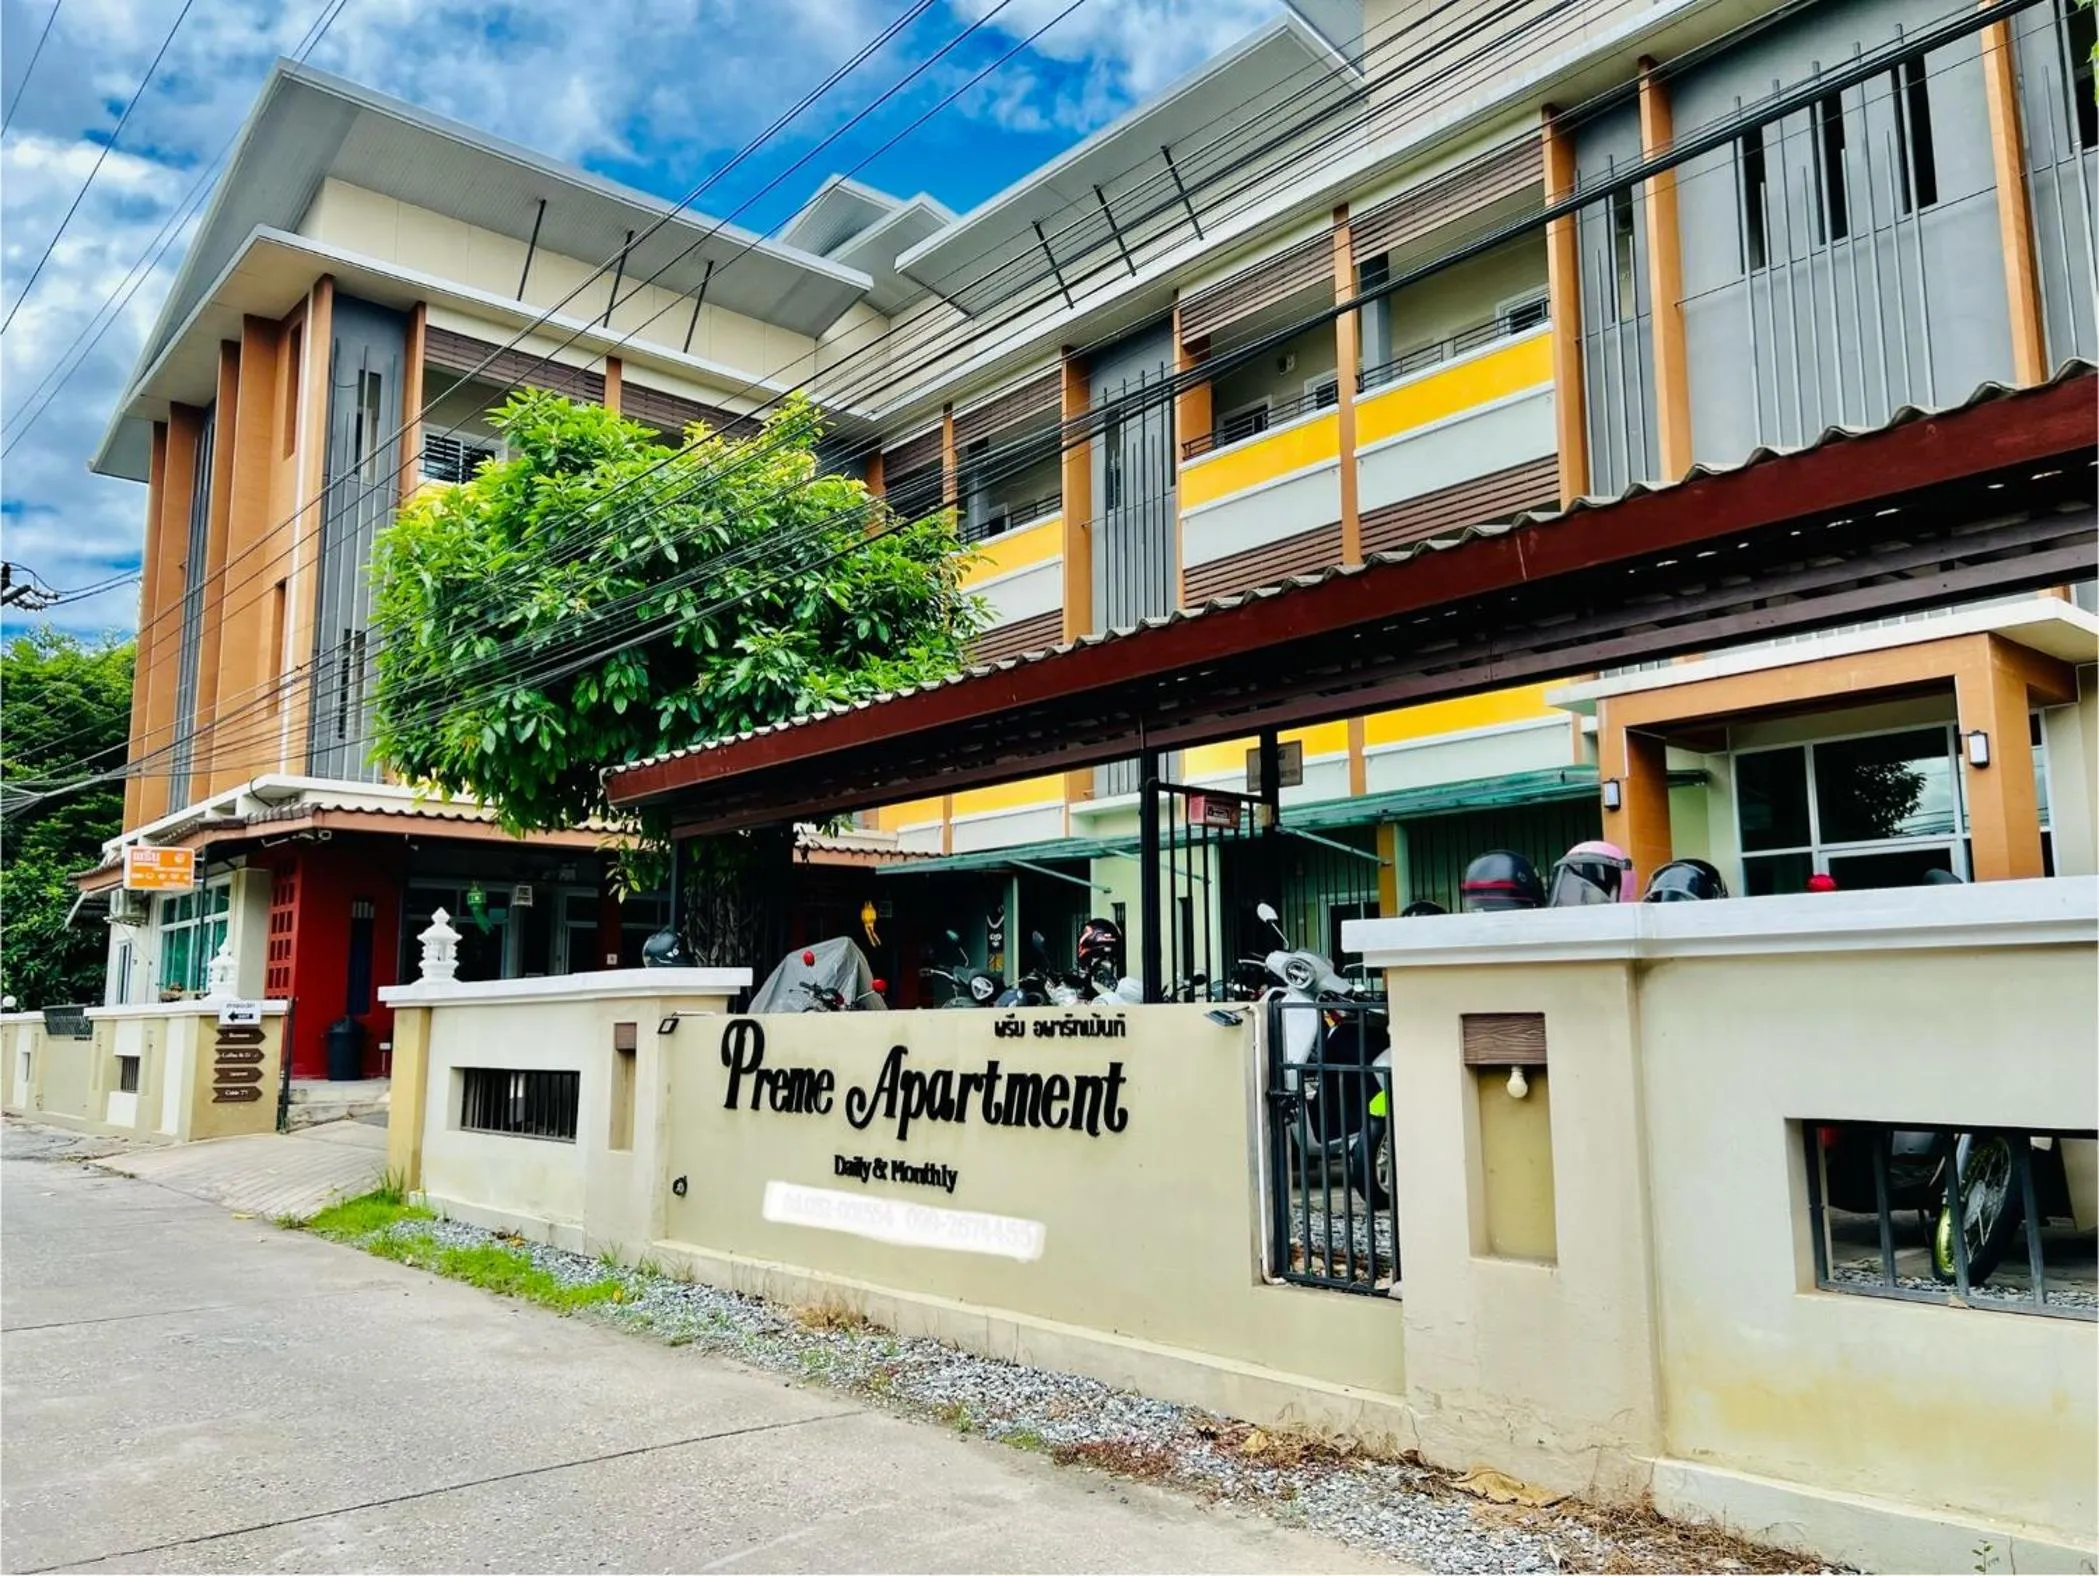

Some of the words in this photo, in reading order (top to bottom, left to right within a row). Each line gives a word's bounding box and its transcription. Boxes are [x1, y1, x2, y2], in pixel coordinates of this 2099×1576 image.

[720, 1018, 835, 1116] Preme
[845, 1044, 1129, 1142] Apartment
[834, 1154, 873, 1184] Daily
[872, 1157, 889, 1181] &
[890, 1159, 959, 1194] Monthly
